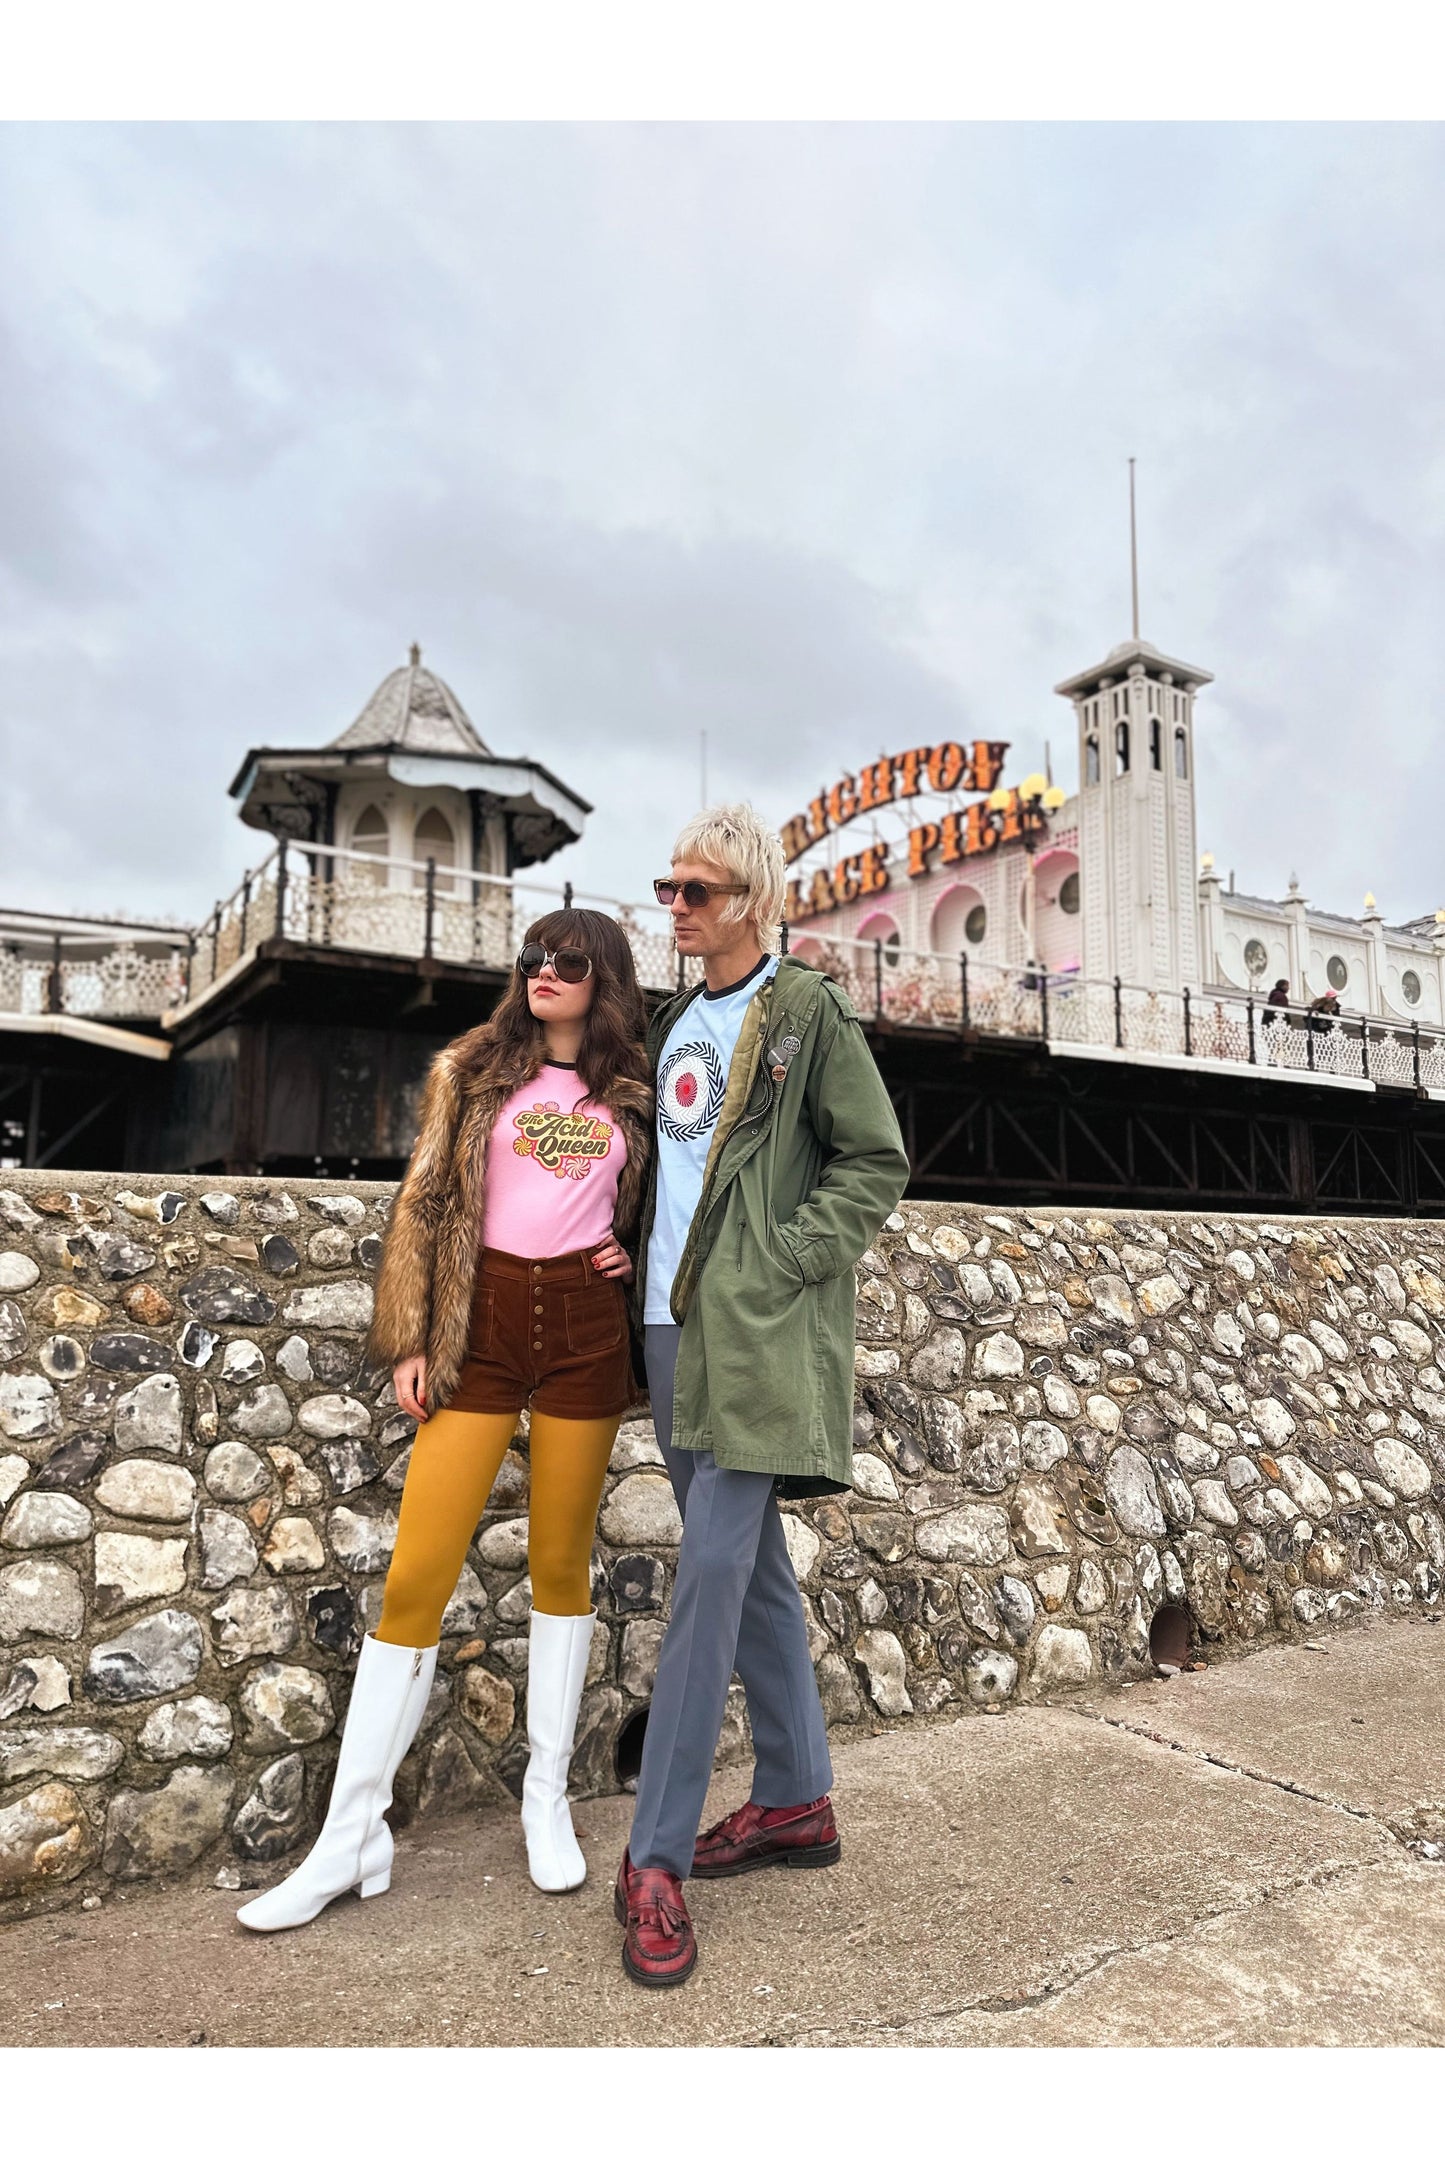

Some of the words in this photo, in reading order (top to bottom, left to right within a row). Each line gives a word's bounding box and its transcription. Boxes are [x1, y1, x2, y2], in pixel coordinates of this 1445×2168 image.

[780, 740, 1010, 866] RIGHTON
[784, 842, 889, 923] LACE
[517, 1113, 544, 1126] The
[525, 1113, 595, 1138] Acid
[535, 1135, 607, 1167] Queen
